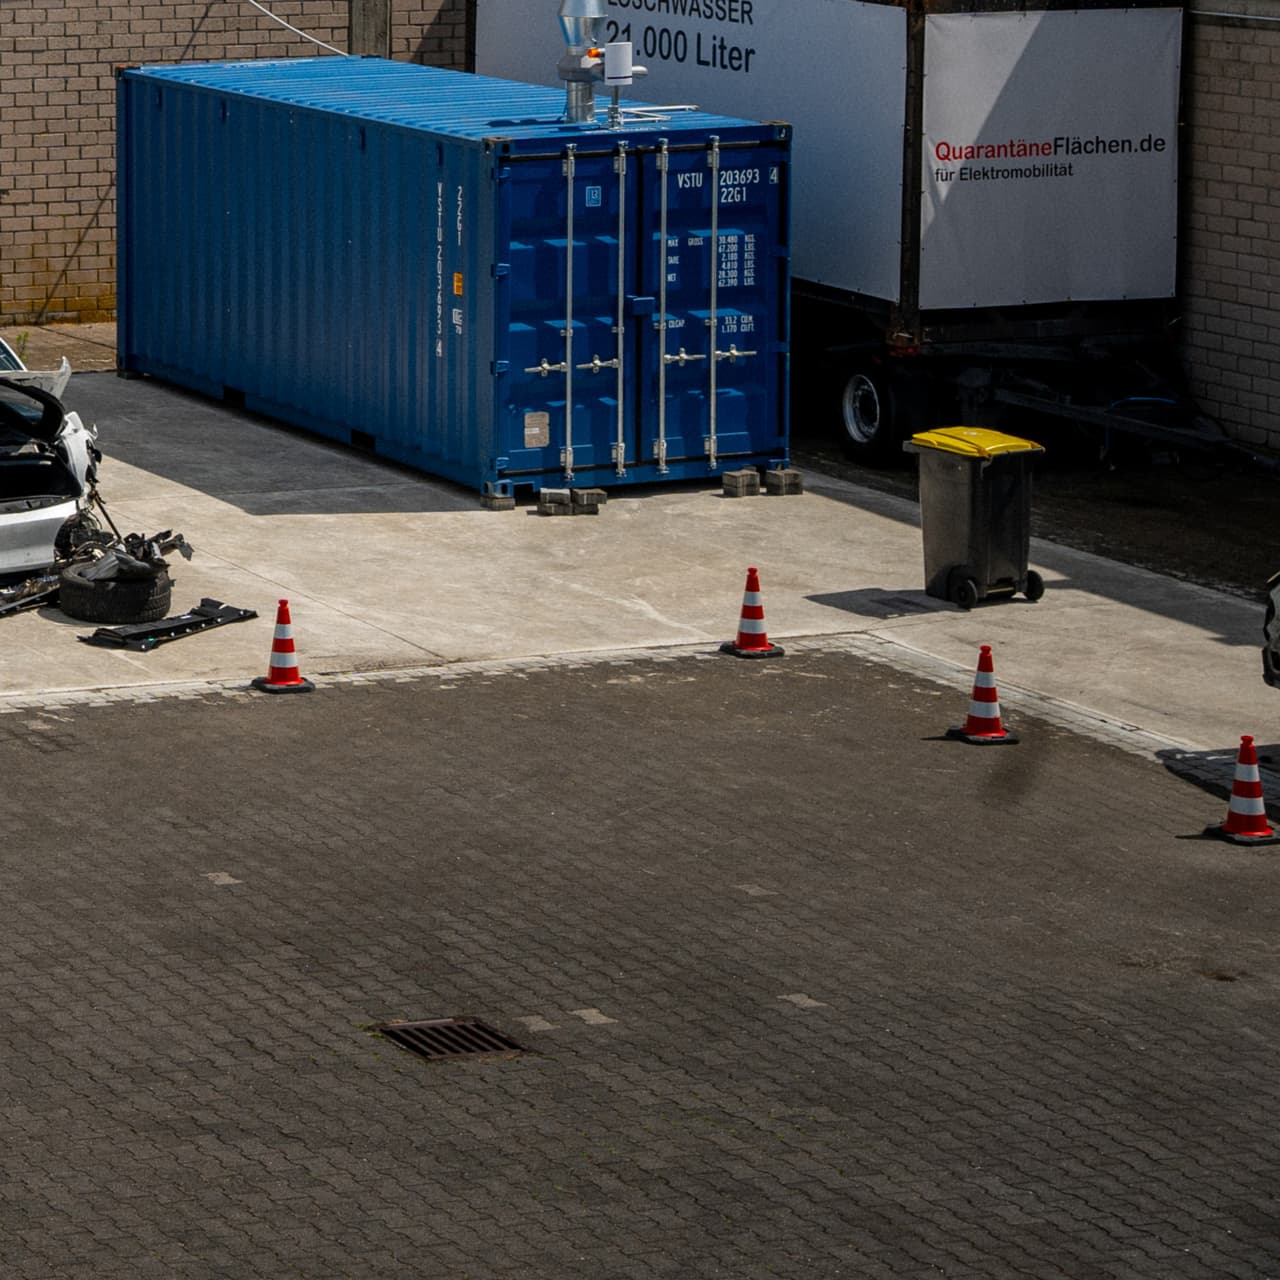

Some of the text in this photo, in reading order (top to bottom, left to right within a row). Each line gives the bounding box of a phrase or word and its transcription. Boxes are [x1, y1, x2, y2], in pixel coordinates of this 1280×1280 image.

[696, 32, 756, 73] Liter
[935, 134, 1167, 162] QuarantäneFlächen.de
[677, 172, 703, 189] VSTU
[720, 168, 760, 186] 203693
[935, 162, 1074, 182] für Elektromobilität
[721, 187, 747, 203] 22G1
